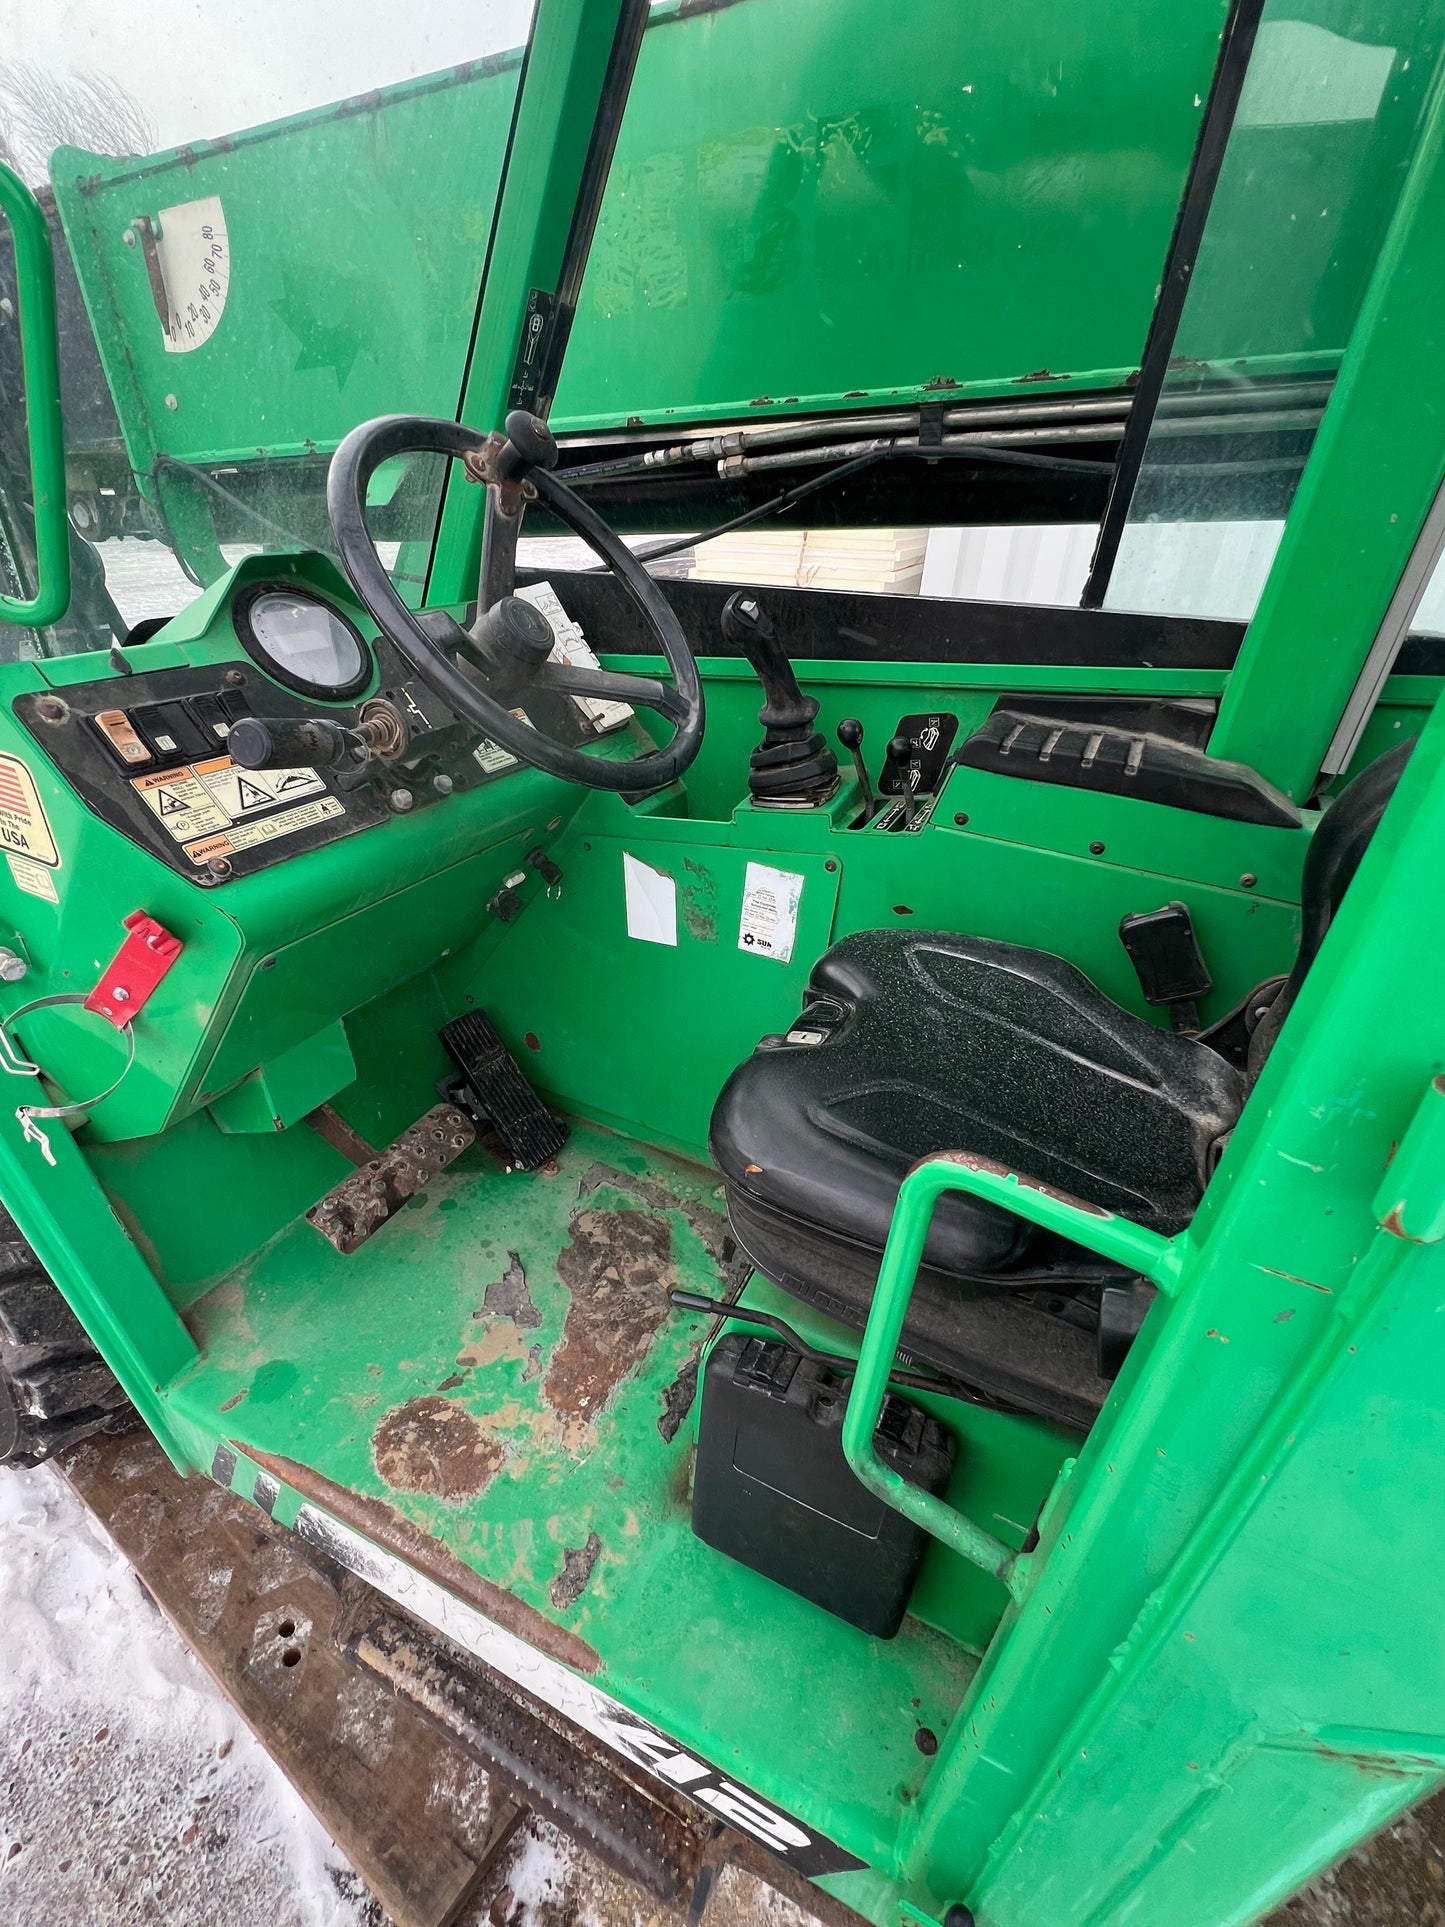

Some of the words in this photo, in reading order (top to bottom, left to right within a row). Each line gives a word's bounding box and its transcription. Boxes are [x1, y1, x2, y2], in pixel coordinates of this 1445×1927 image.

[202, 225, 214, 241] 80
[211, 243, 223, 260] 70
[203, 257, 215, 275] 60
[198, 284, 211, 302] 40
[208, 278, 221, 298] 50
[187, 302, 199, 322] 20
[199, 304, 211, 325] 30
[185, 319, 195, 339] 10
[152, 771, 184, 784] WARNING
[14, 813, 33, 827] Pride
[1, 827, 30, 850] USA
[199, 840, 230, 855] WARNING
